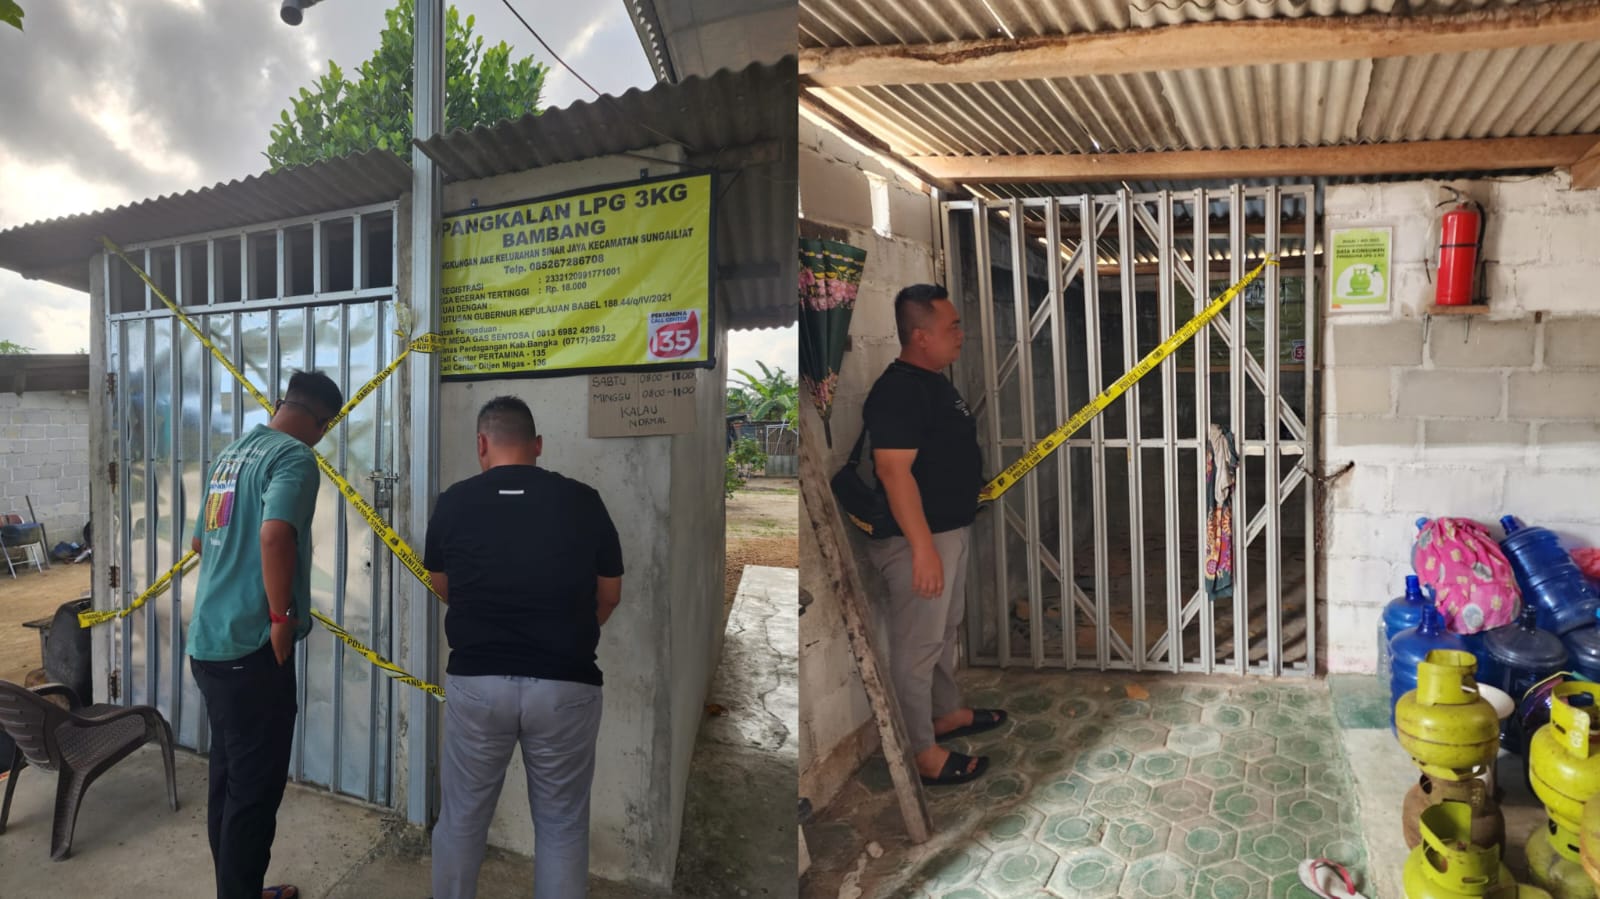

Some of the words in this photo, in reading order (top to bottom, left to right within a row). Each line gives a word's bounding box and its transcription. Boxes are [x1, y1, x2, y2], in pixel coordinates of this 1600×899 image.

[442, 202, 570, 236] PANGKALAN
[580, 194, 626, 216] LPG
[635, 184, 688, 208] 3KG
[502, 220, 606, 248] BAMBANG
[480, 255, 494, 264] AKE
[496, 249, 540, 262] KELURAHAN
[542, 245, 565, 256] SINAR
[567, 242, 586, 253] JAYA
[588, 236, 638, 250] KECAMATAN
[640, 228, 694, 243] SUNGAILIAT
[504, 265, 526, 275] Telp.
[455, 294, 486, 303] ECERAN
[488, 288, 530, 299] TERTINGGI
[456, 303, 488, 312] DENGAN
[474, 310, 517, 320] GUBERNUR
[520, 304, 570, 316] KEPULAUAN
[572, 301, 601, 310] BABEL
[449, 336, 470, 344] MEGA
[491, 332, 530, 341] SENTOSA
[652, 330, 691, 352] 135
[460, 343, 507, 353] Perdagangan
[478, 351, 524, 360] PERTAMINA
[532, 349, 546, 357] 135
[592, 376, 626, 388] SABTU
[1118, 372, 1137, 389] POLICE
[1137, 362, 1150, 374] LINE
[593, 393, 631, 403] MINGGU
[621, 405, 658, 418] KALAU
[629, 417, 668, 428] NORMAL
[1011, 462, 1029, 479] POLICE
[1029, 452, 1041, 465] LINE
